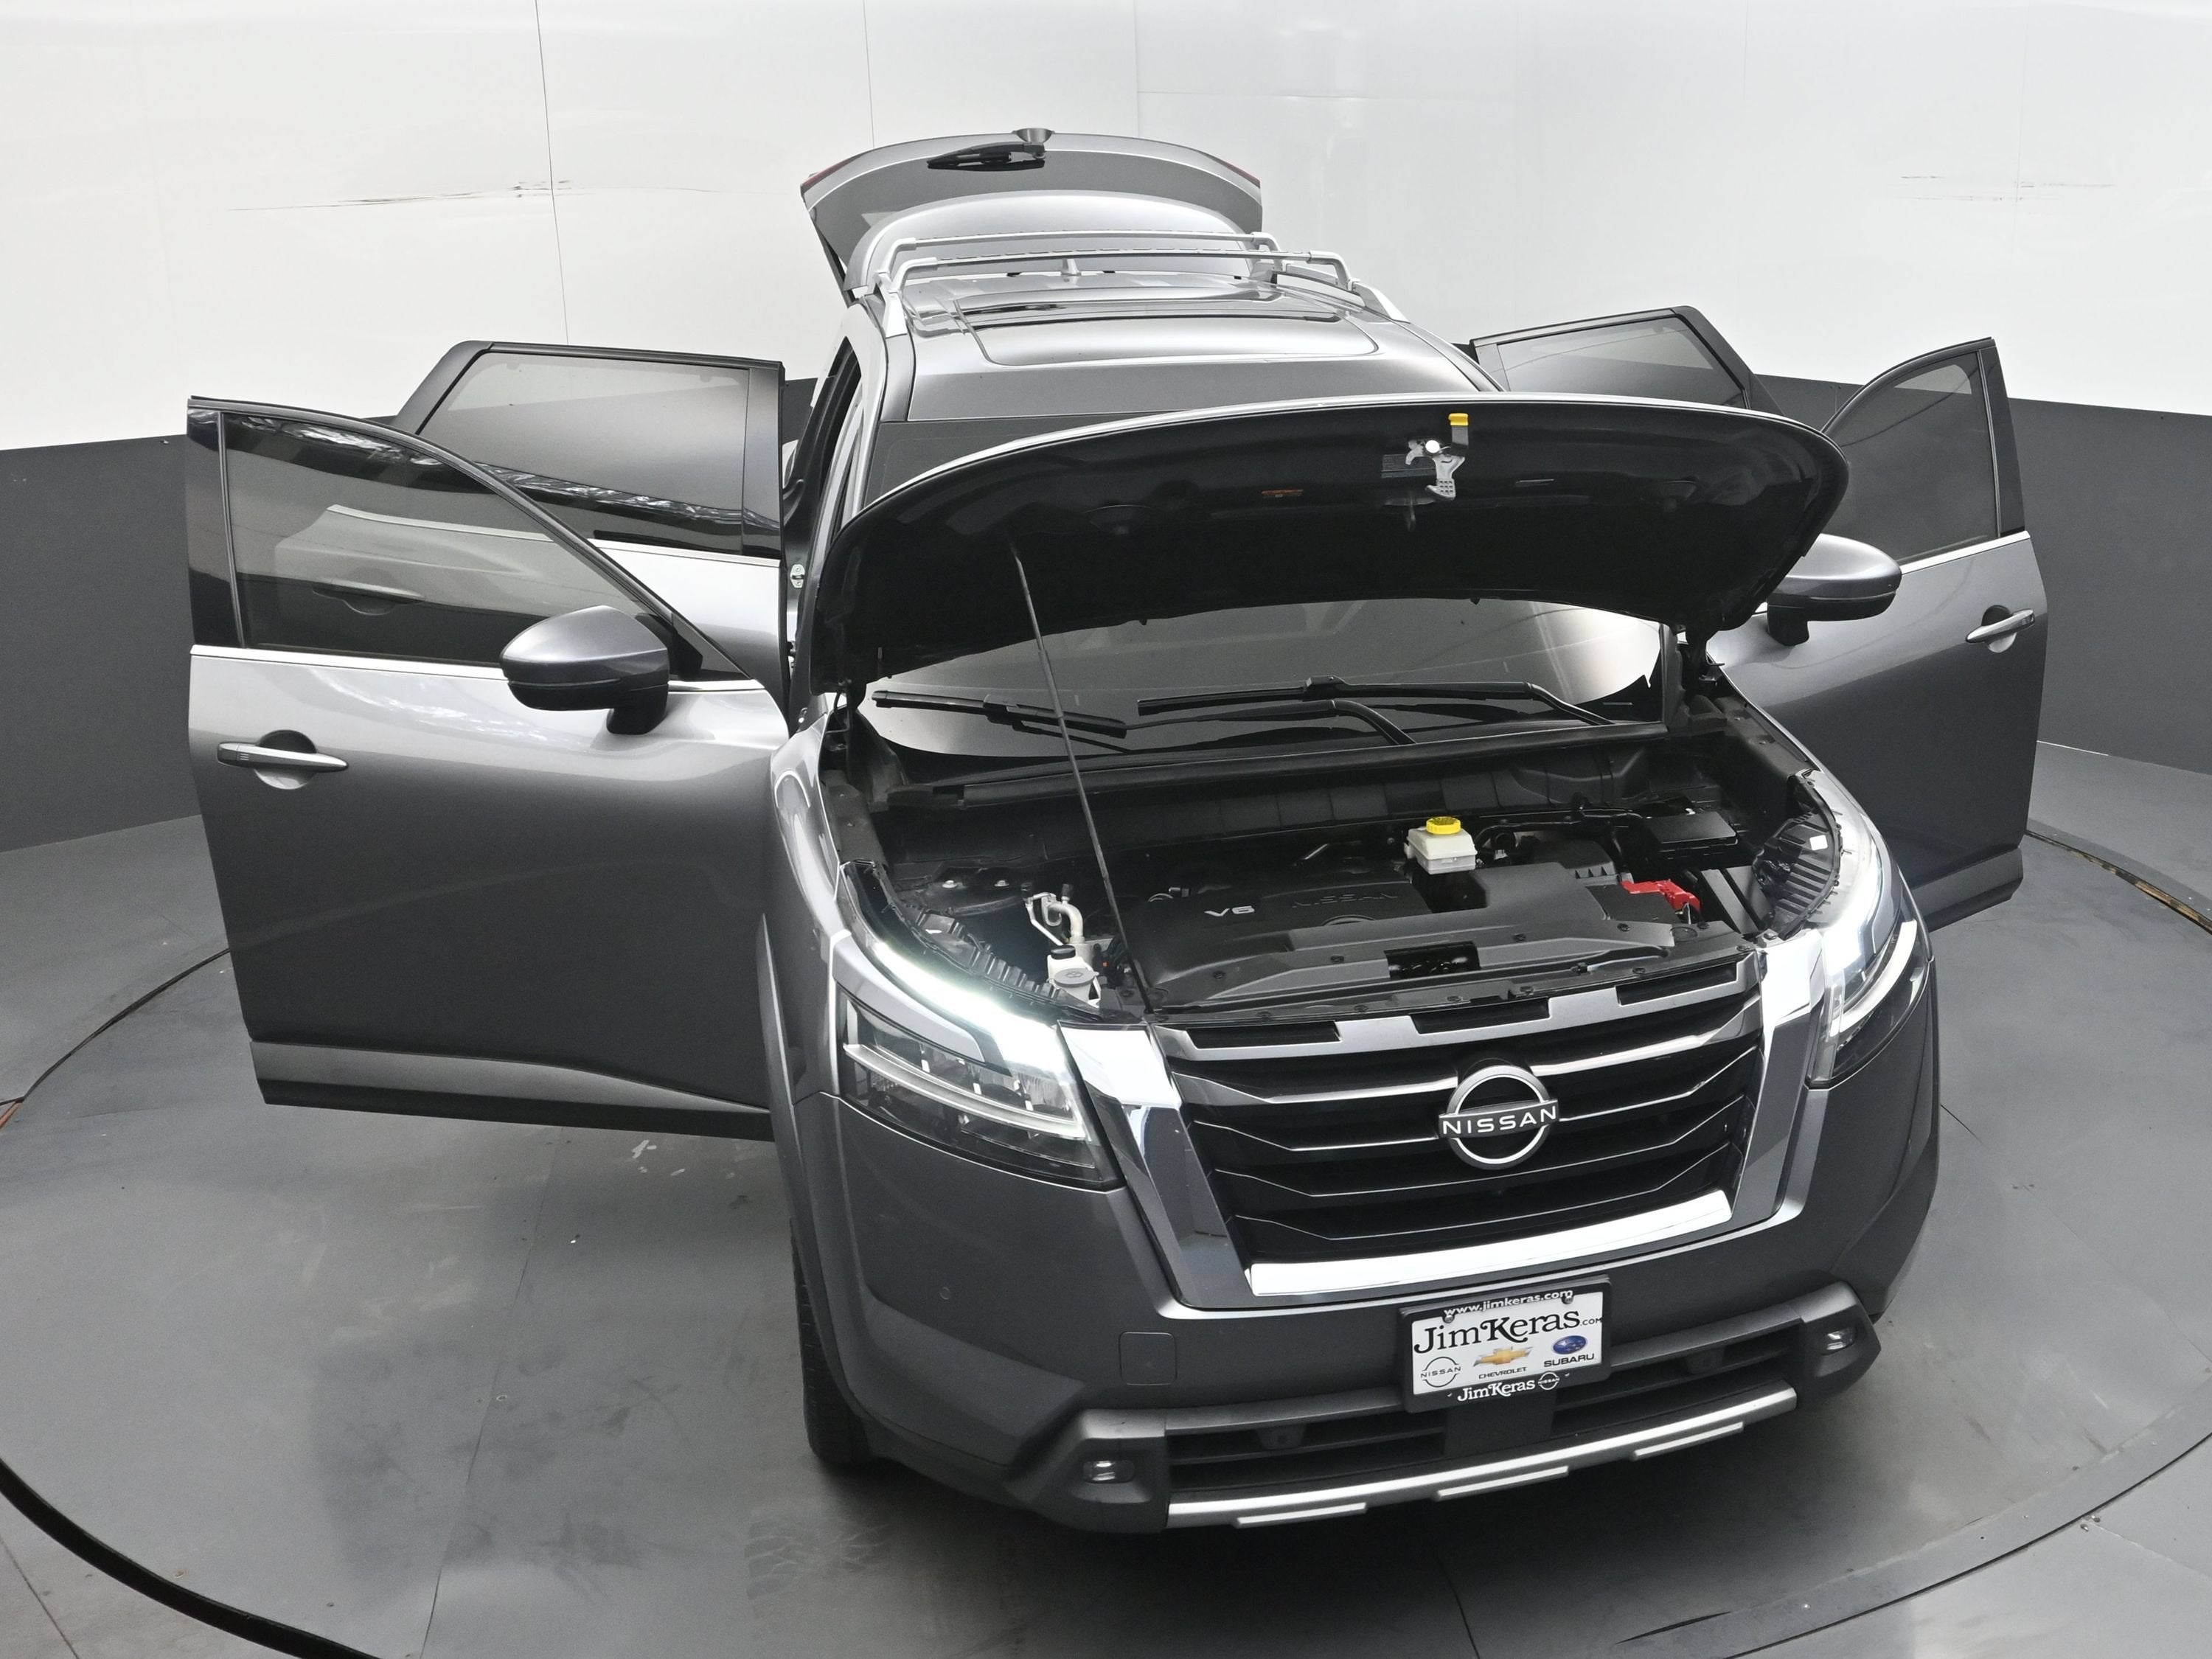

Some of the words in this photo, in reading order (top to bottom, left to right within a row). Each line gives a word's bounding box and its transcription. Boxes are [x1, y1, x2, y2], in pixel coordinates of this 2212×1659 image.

[1204, 905, 1255, 917] V6
[1442, 1105, 1557, 1135] NISSAN
[1444, 1290, 1573, 1316] www.jimkeras.com
[1543, 1353, 1595, 1368] SUBARU
[1420, 1366, 1461, 1379] NISSAN
[1478, 1366, 1528, 1380] CHEVROLET
